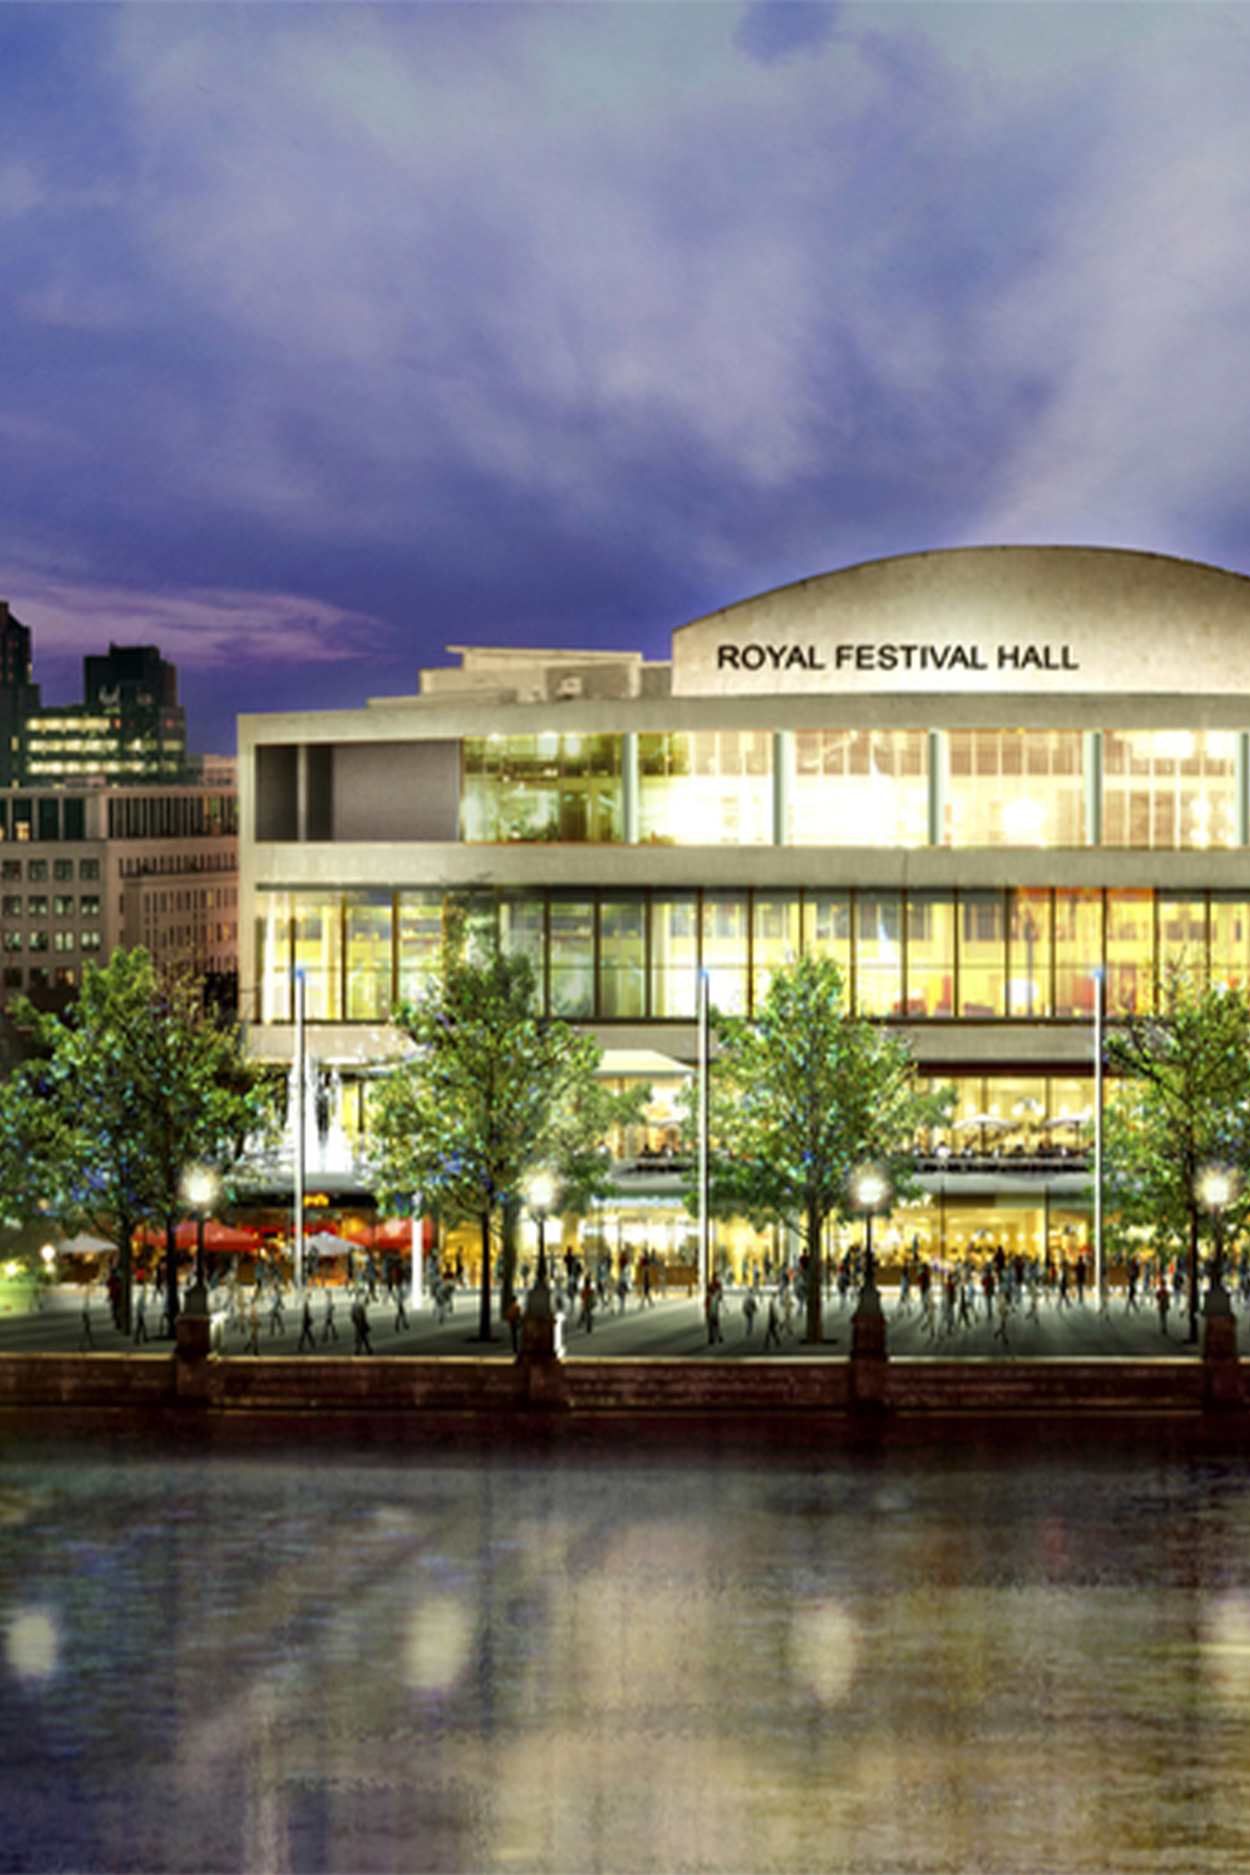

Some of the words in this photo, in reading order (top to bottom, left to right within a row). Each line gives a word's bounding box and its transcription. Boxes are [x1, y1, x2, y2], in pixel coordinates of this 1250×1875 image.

[717, 644, 825, 670] ROYAL
[835, 644, 987, 670] FESTIVAL
[997, 644, 1079, 670] HALL
